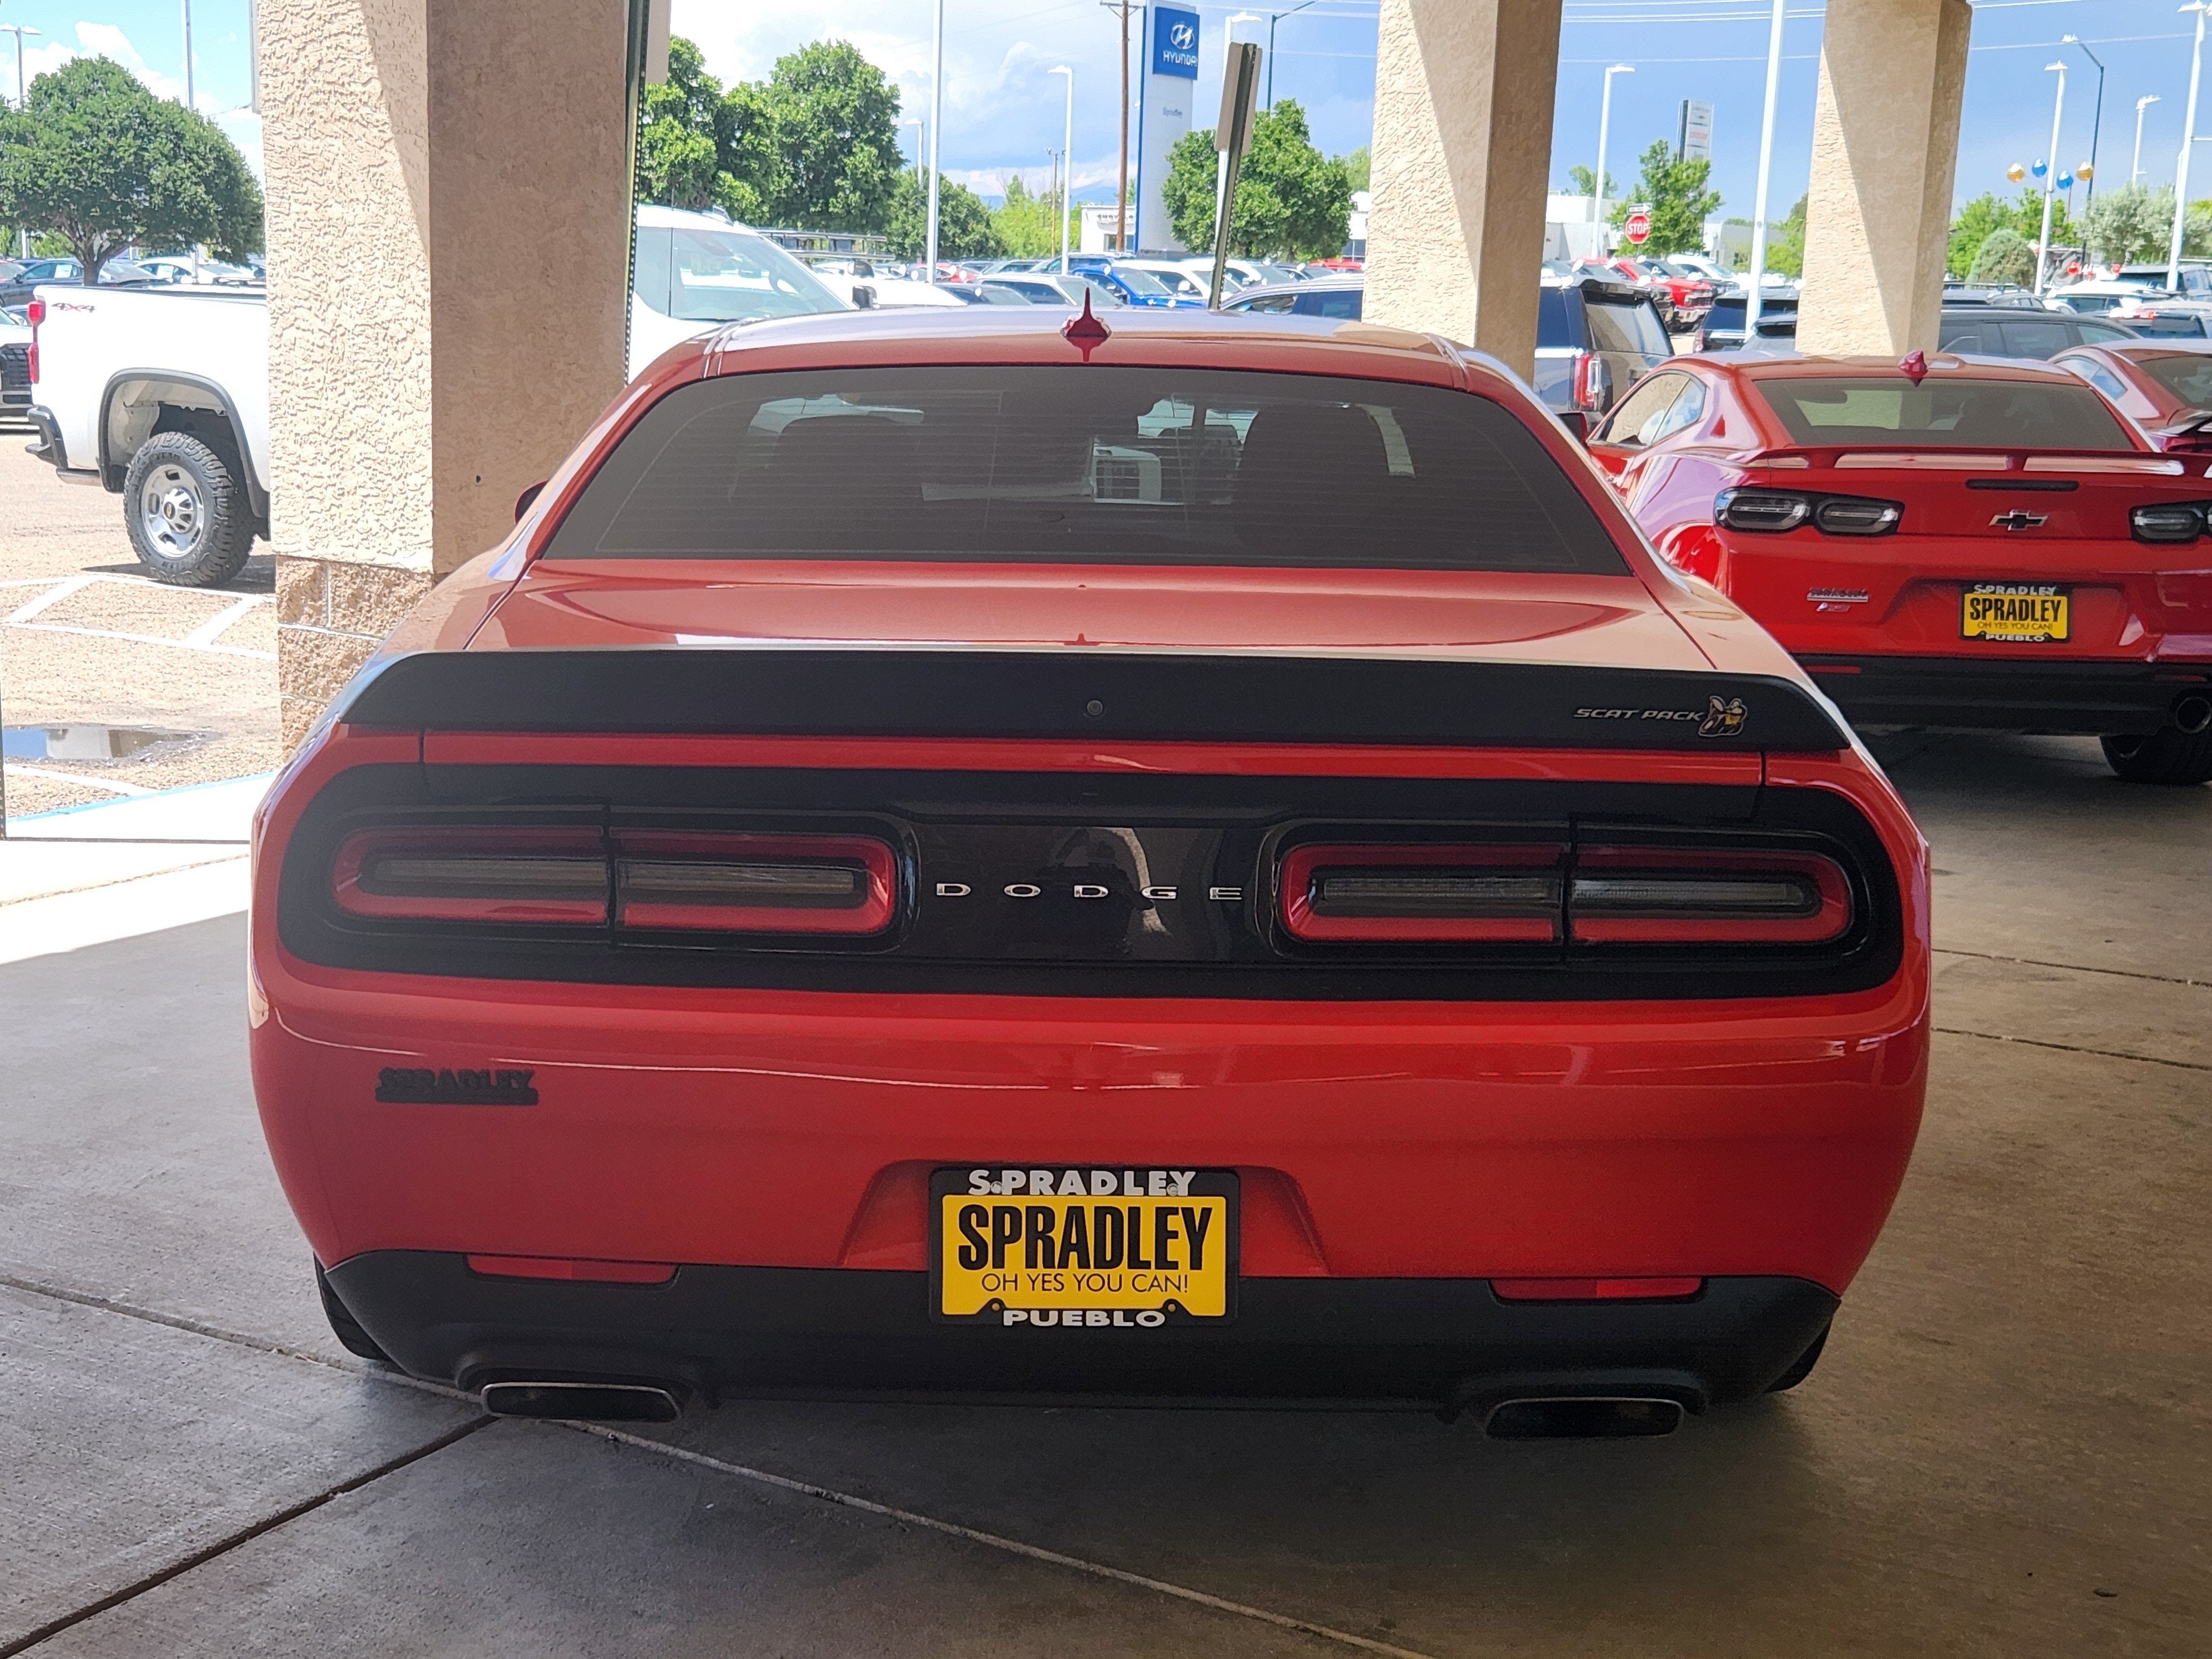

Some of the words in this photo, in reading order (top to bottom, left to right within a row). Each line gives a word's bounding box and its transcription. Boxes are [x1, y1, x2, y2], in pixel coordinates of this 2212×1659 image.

[1163, 50, 1198, 67] HYUNDAI
[1627, 223, 1650, 235] STOP
[1973, 584, 2057, 596] SPRADLEY
[1969, 597, 2062, 622] SPRADLEY
[1574, 708, 1639, 719] SCAT
[1641, 710, 1705, 721] PACK
[937, 883, 1243, 900] DODGE
[968, 1169, 1196, 1196] SPRADLEY
[958, 1203, 1213, 1271] SPRADLEY
[981, 1272, 1018, 1292] OH
[1027, 1273, 1065, 1292] YES
[1076, 1273, 1123, 1292] YOU
[1131, 1273, 1189, 1293] CAN!
[1003, 1310, 1166, 1327] PUEBLO
